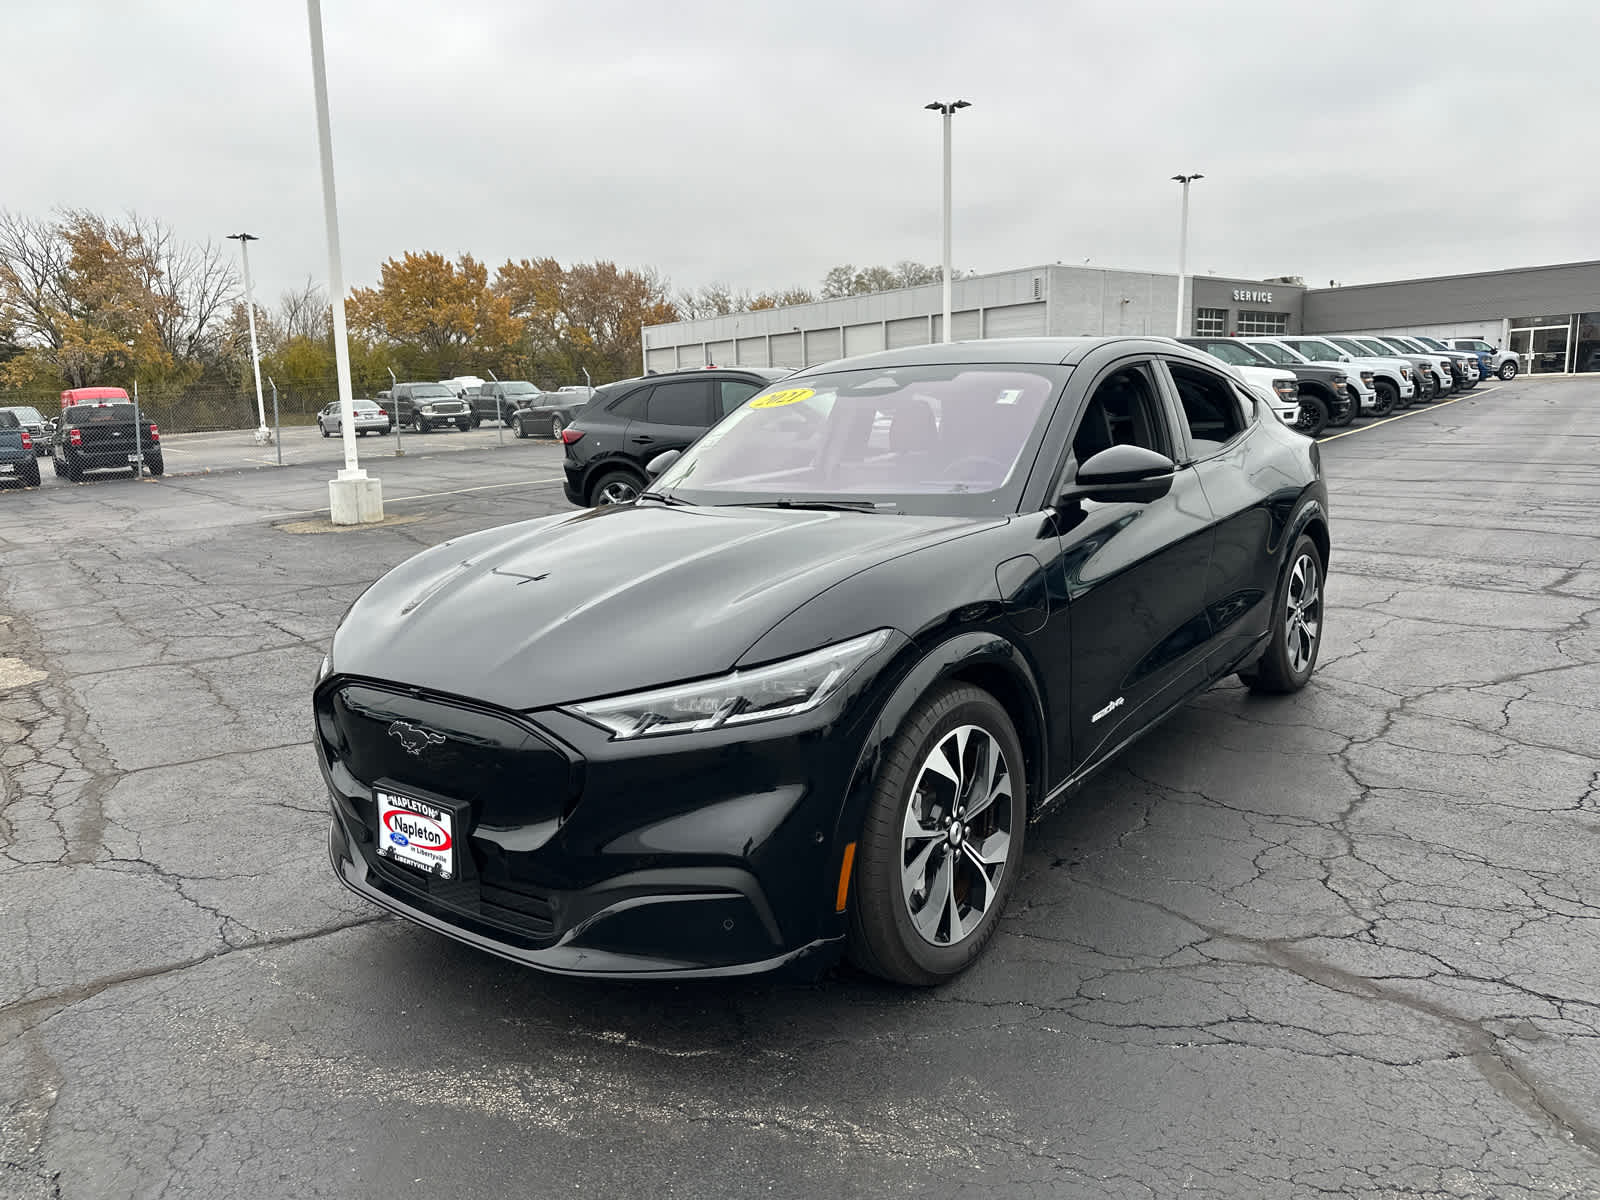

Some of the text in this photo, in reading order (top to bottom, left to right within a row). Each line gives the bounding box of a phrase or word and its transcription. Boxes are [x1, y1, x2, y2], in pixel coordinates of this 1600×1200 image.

[1233, 289, 1273, 302] SERVICE
[394, 815, 441, 845] Napleton
[394, 854, 433, 873] LIBERTYVILLE
[416, 847, 446, 863] Libertyville
